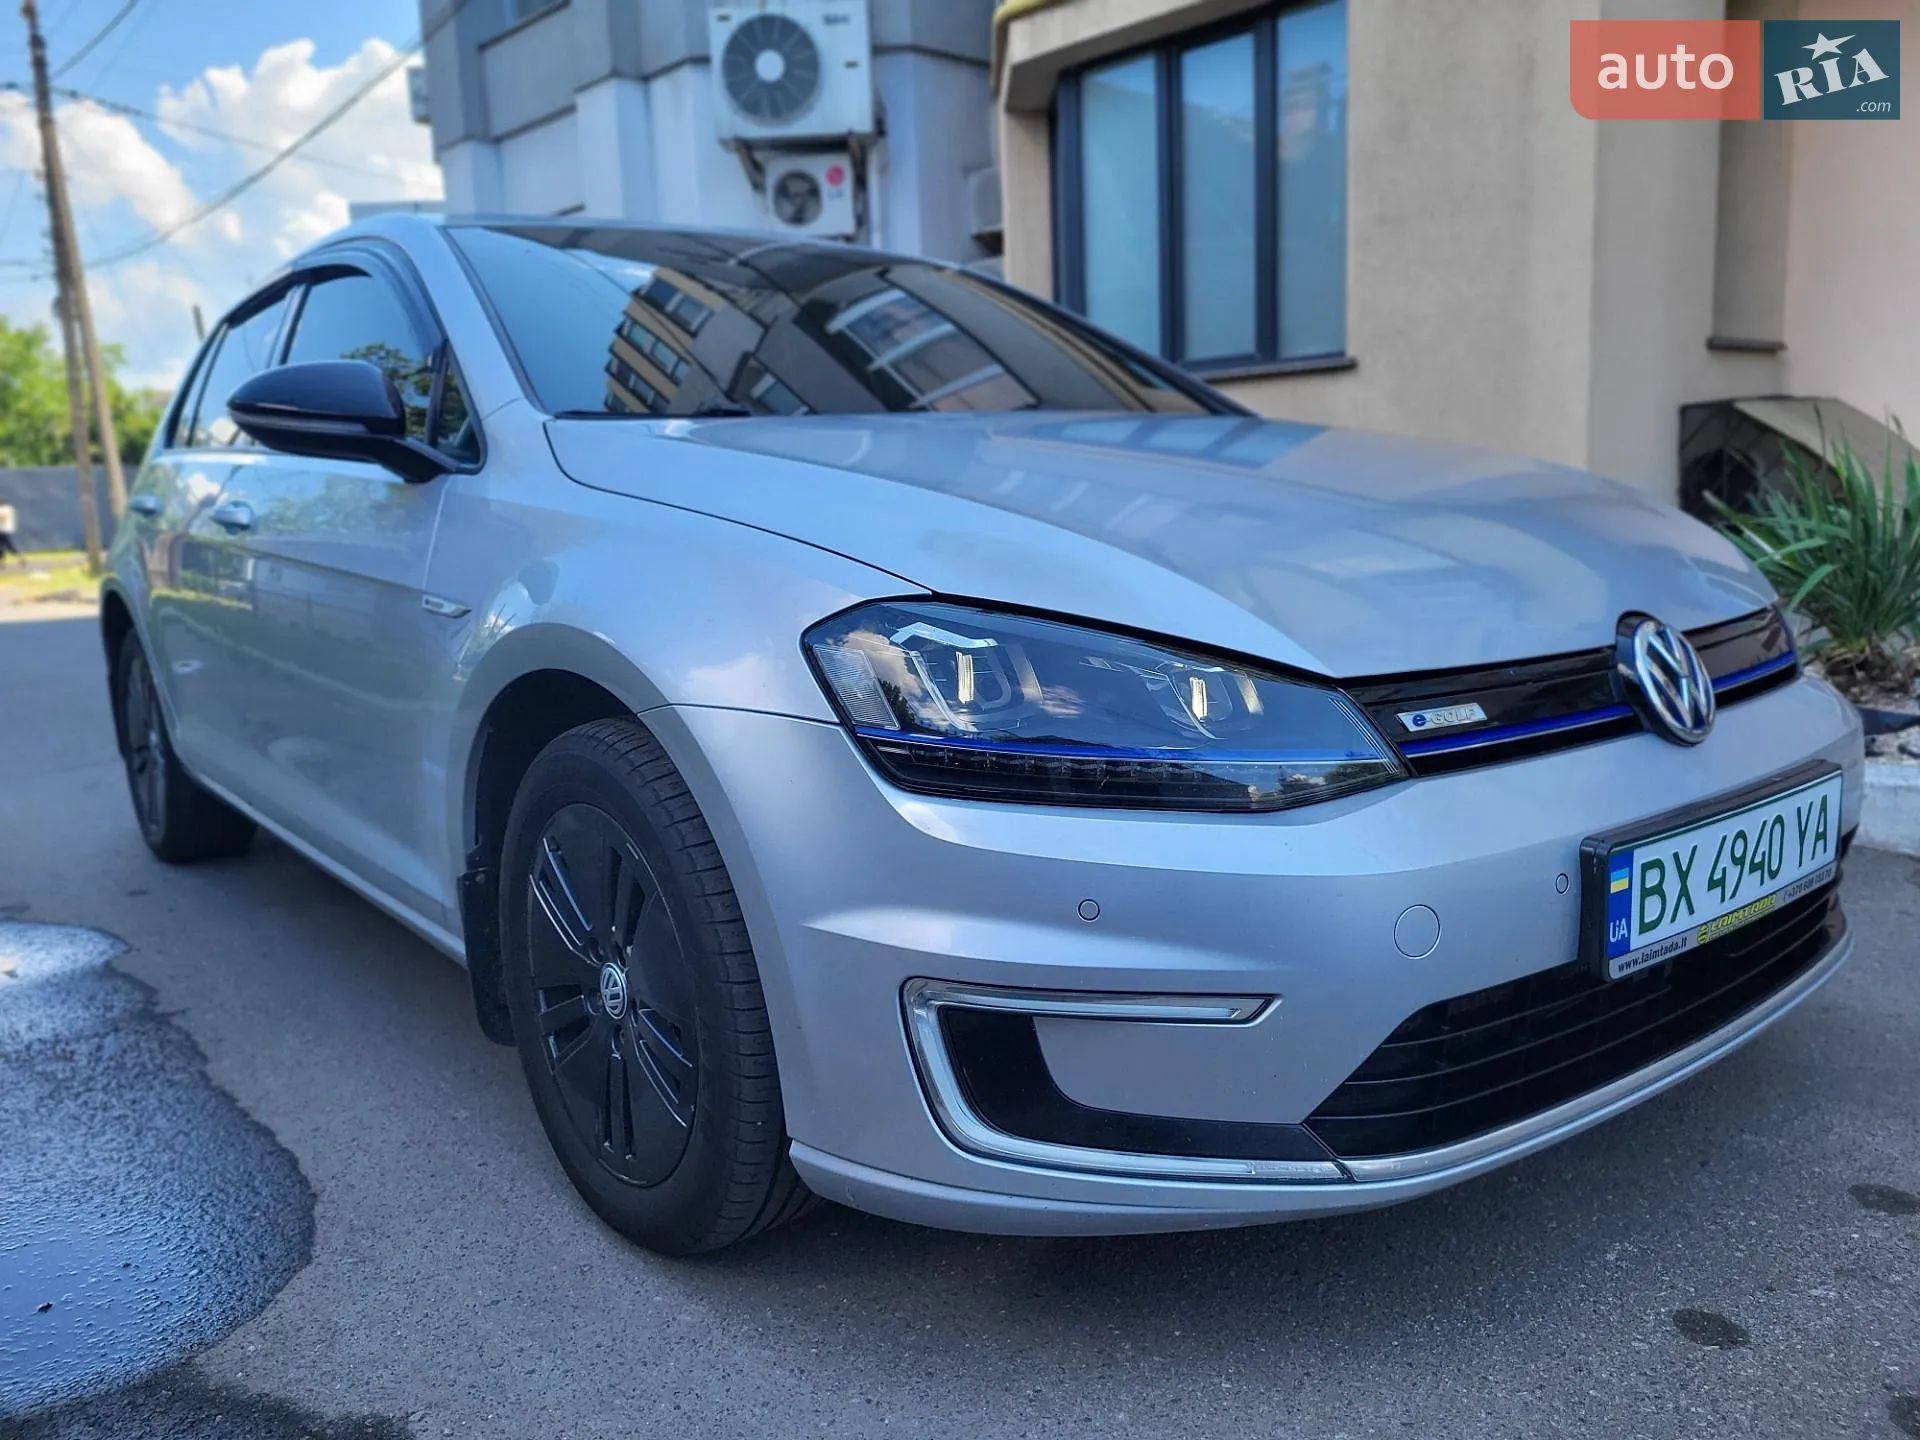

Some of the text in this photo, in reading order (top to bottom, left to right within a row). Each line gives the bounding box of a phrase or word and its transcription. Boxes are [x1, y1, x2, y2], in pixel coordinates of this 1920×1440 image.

[1638, 794, 1828, 936] BX 4940 YA
[1609, 917, 1629, 943] UA
